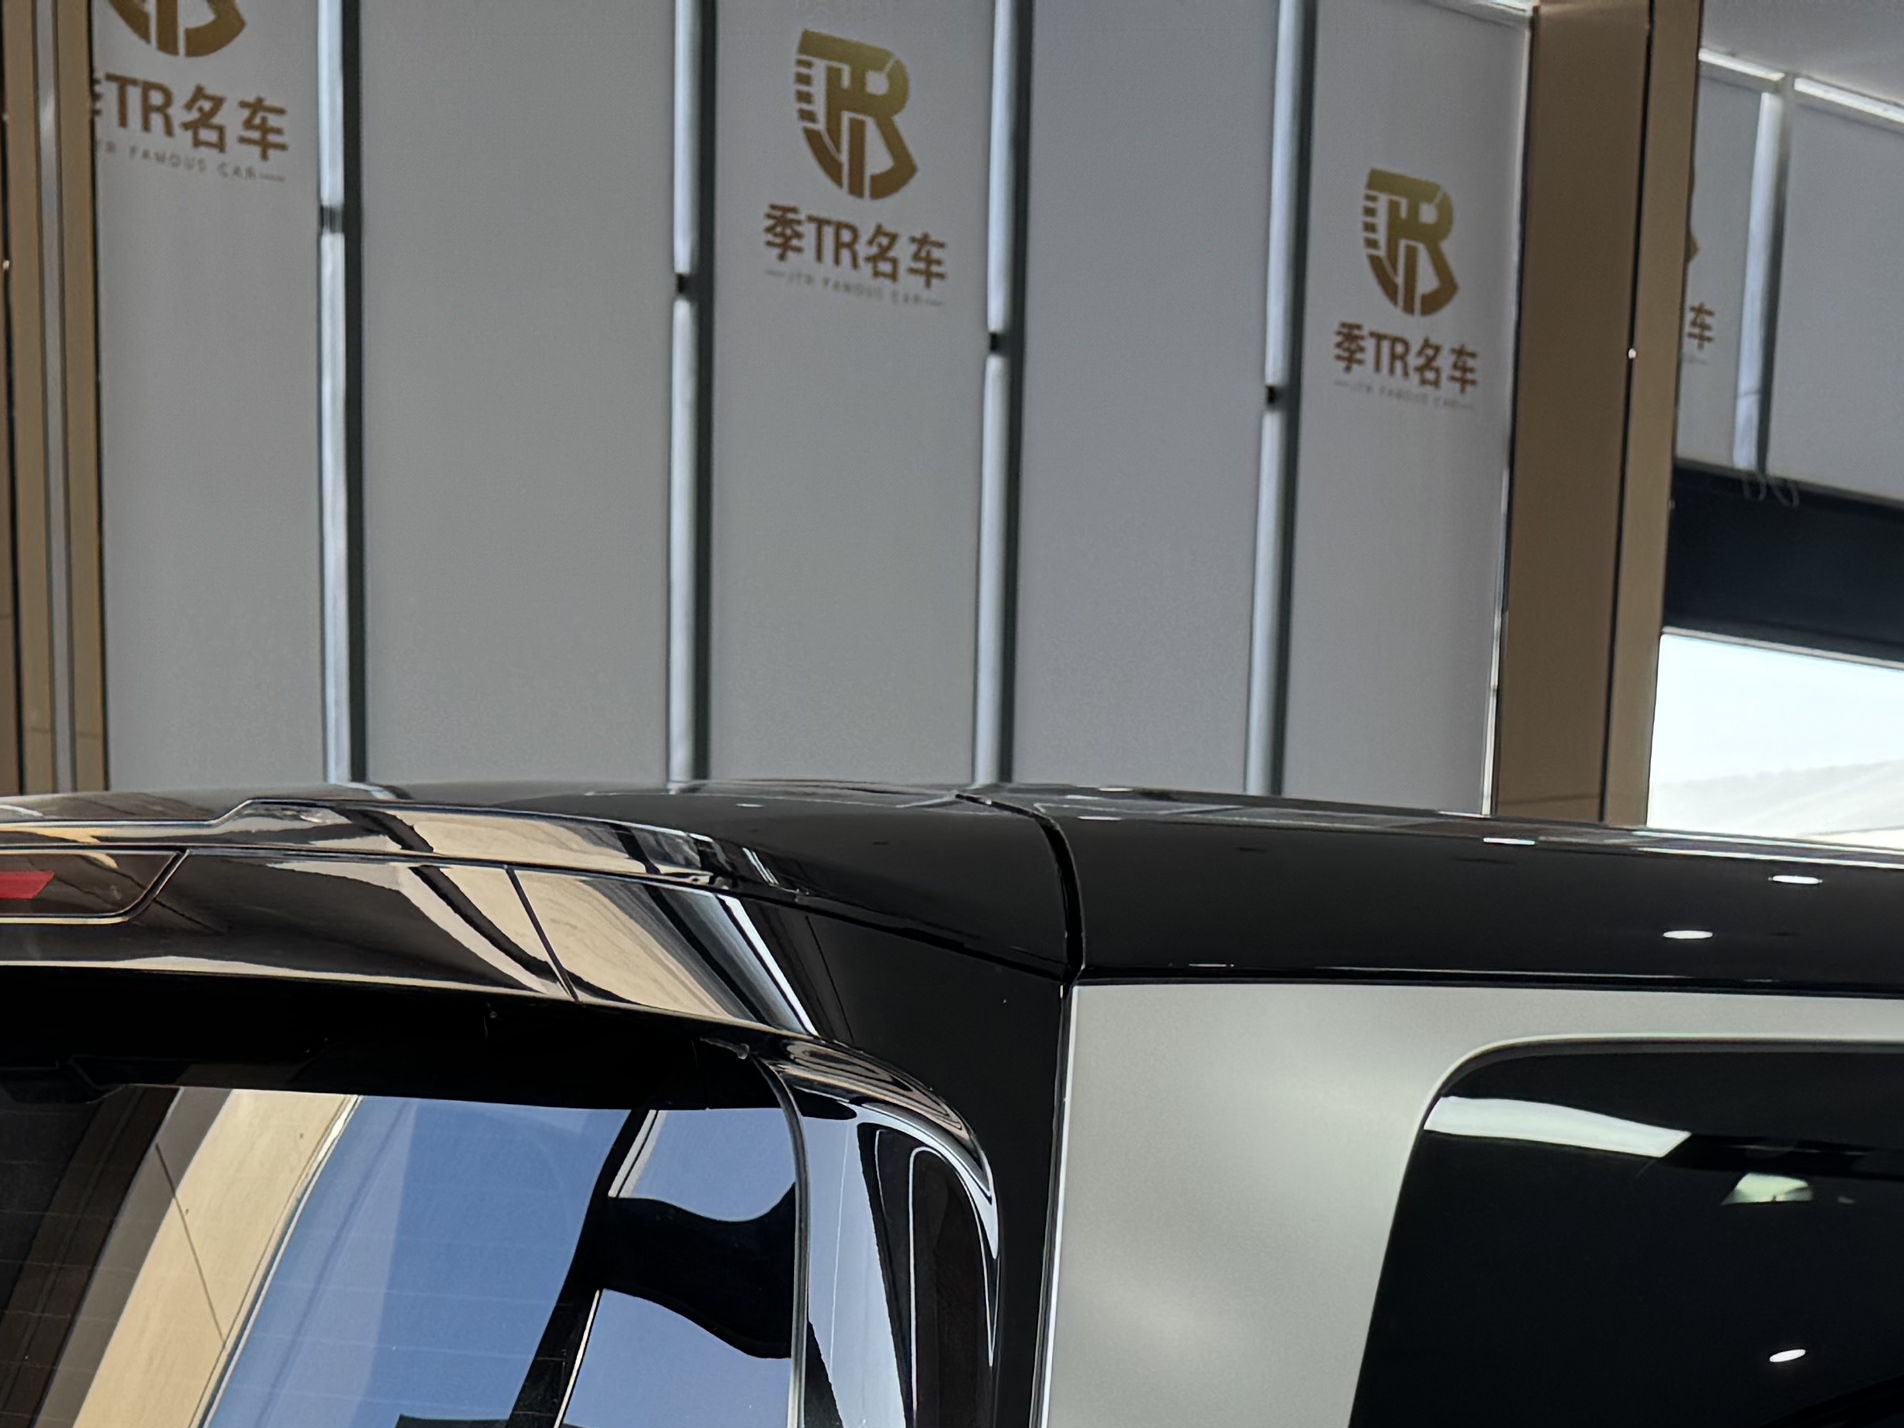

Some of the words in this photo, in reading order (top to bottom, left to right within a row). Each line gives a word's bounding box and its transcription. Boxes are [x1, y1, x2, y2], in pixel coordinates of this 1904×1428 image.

[93, 72, 289, 161] TR名车
[764, 203, 948, 289] 季TR名车
[1334, 321, 1480, 394] 季TR名车
